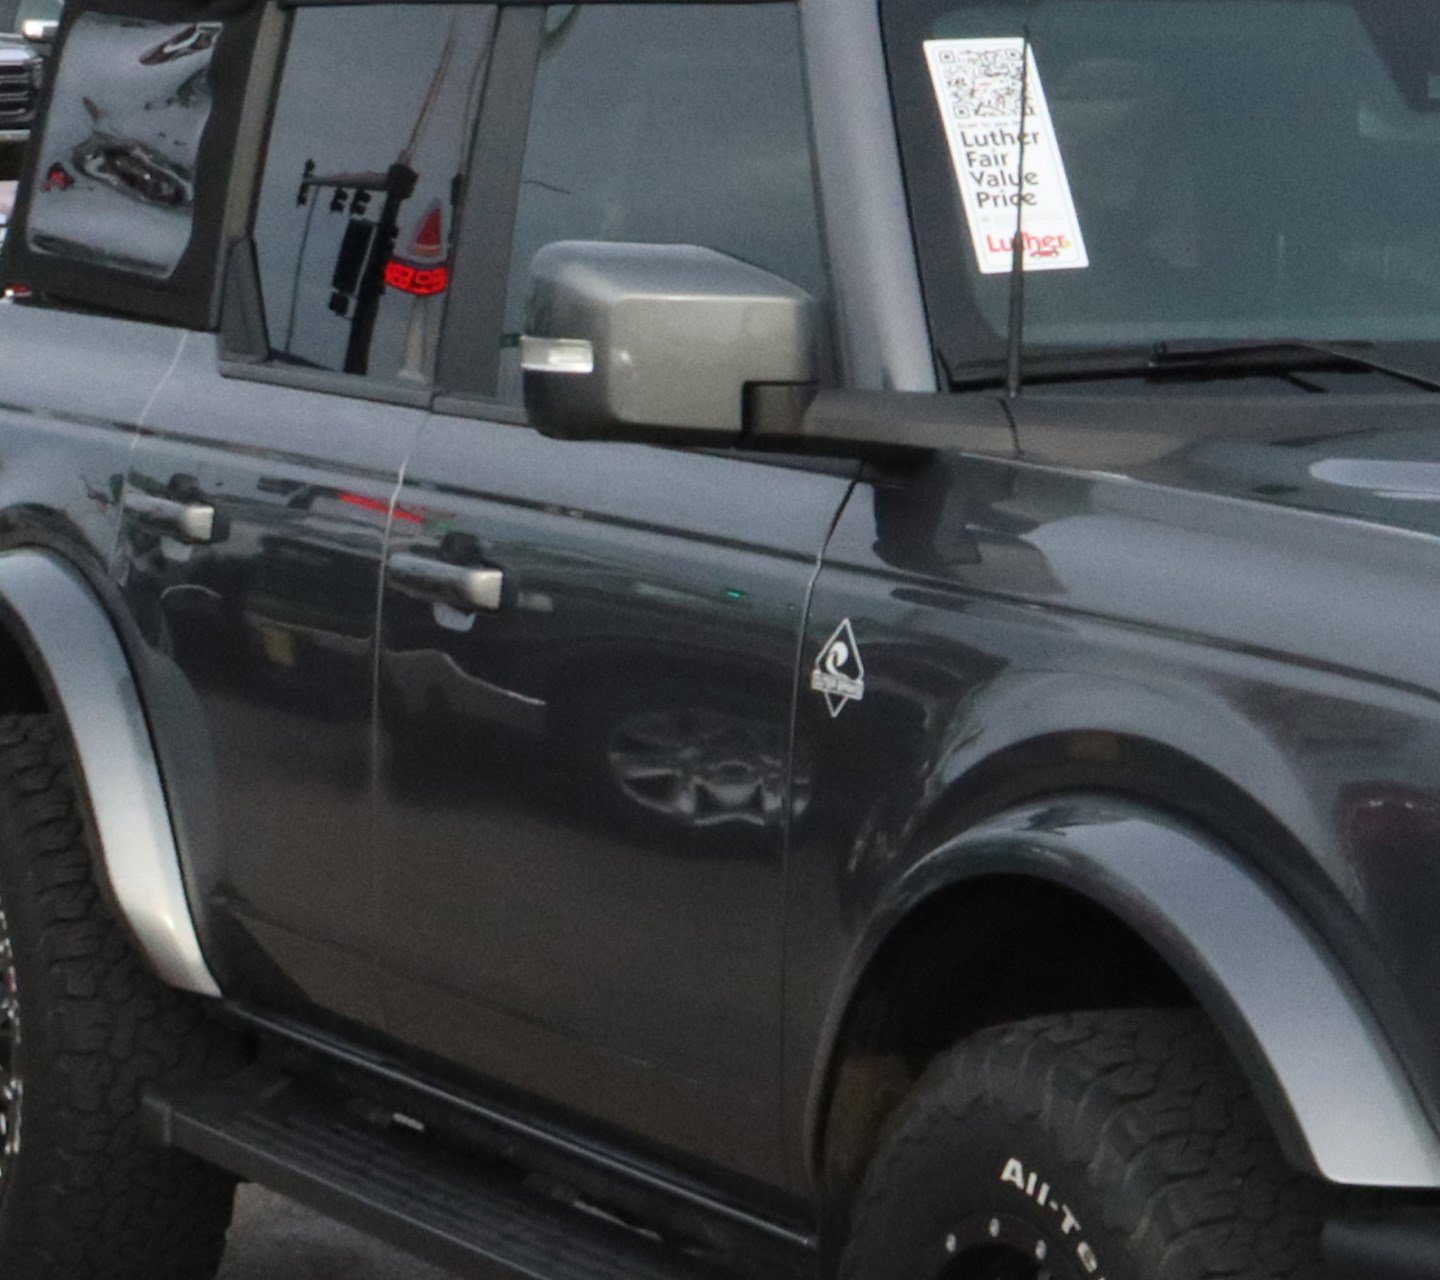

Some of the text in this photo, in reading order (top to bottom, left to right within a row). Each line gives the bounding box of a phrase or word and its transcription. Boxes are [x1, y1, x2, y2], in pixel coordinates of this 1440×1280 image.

[961, 129, 1039, 147] Luther
[966, 150, 1008, 167] Fair
[970, 170, 1039, 187] Value
[976, 191, 1038, 208] Price
